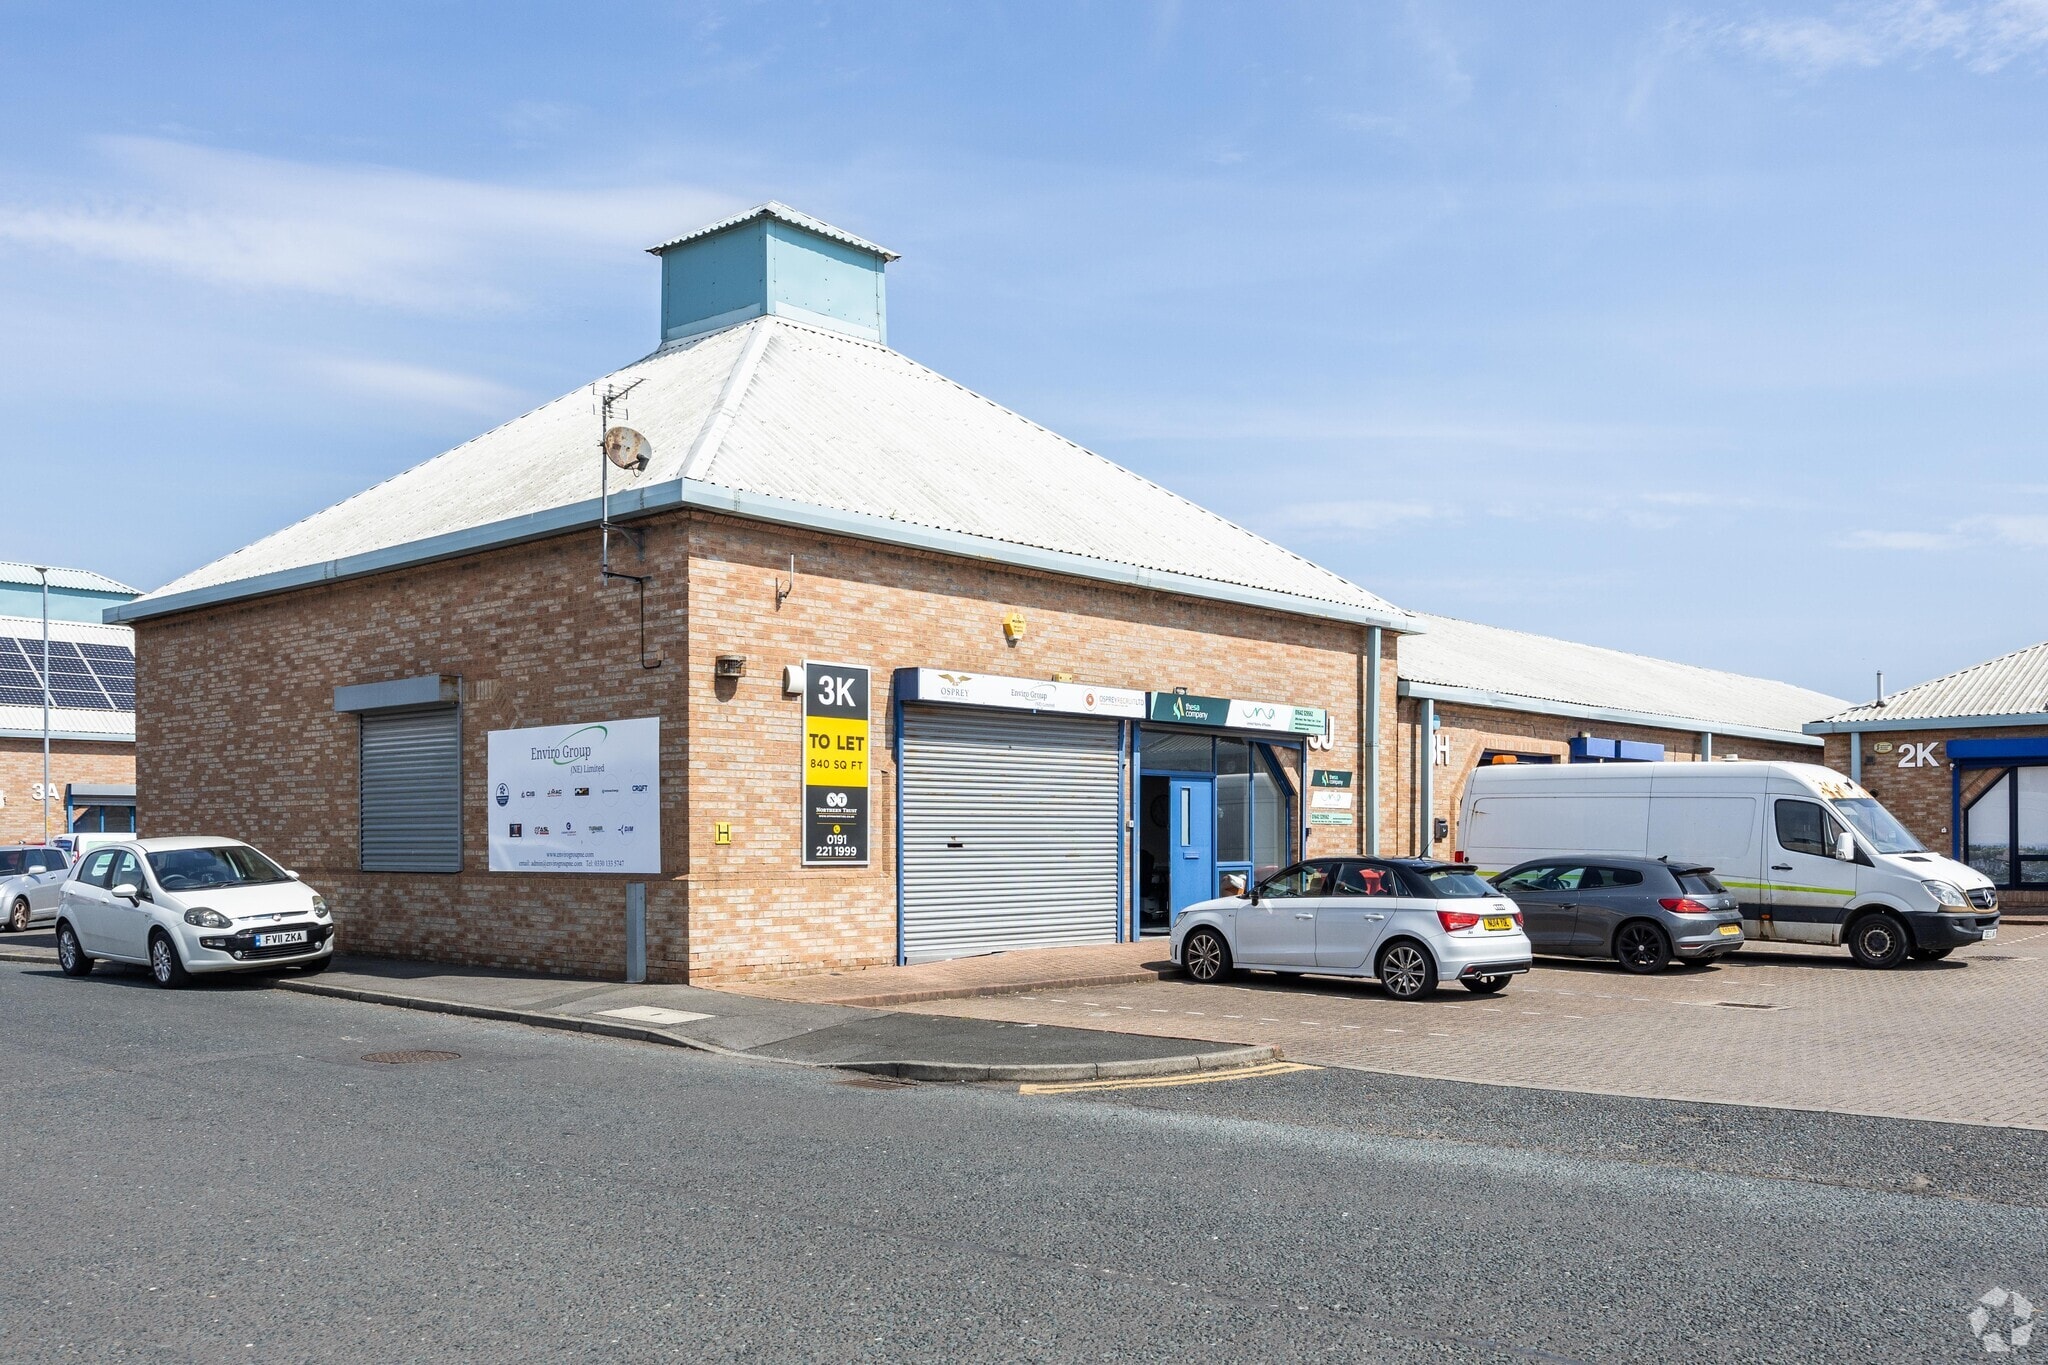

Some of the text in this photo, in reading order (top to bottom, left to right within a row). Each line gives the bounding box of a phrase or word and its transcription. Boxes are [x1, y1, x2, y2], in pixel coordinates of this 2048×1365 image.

[818, 675, 856, 707] 3K
[941, 687, 969, 697] OSPREY
[1011, 689, 1047, 701] Enviro Group
[1185, 711, 1208, 720] company
[809, 733, 864, 751] TO LET
[531, 745, 591, 761] Enviro Group
[1433, 734, 1449, 765] H
[1898, 741, 1940, 768] 2K
[570, 763, 605, 775] (NE) Limited
[810, 759, 863, 770] 840 SQ FT
[32, 782, 60, 800] 3A
[718, 824, 729, 841] H
[827, 834, 847, 845] 0191
[816, 846, 857, 856] 221 1999
[265, 932, 302, 945] FV11 ZKA
